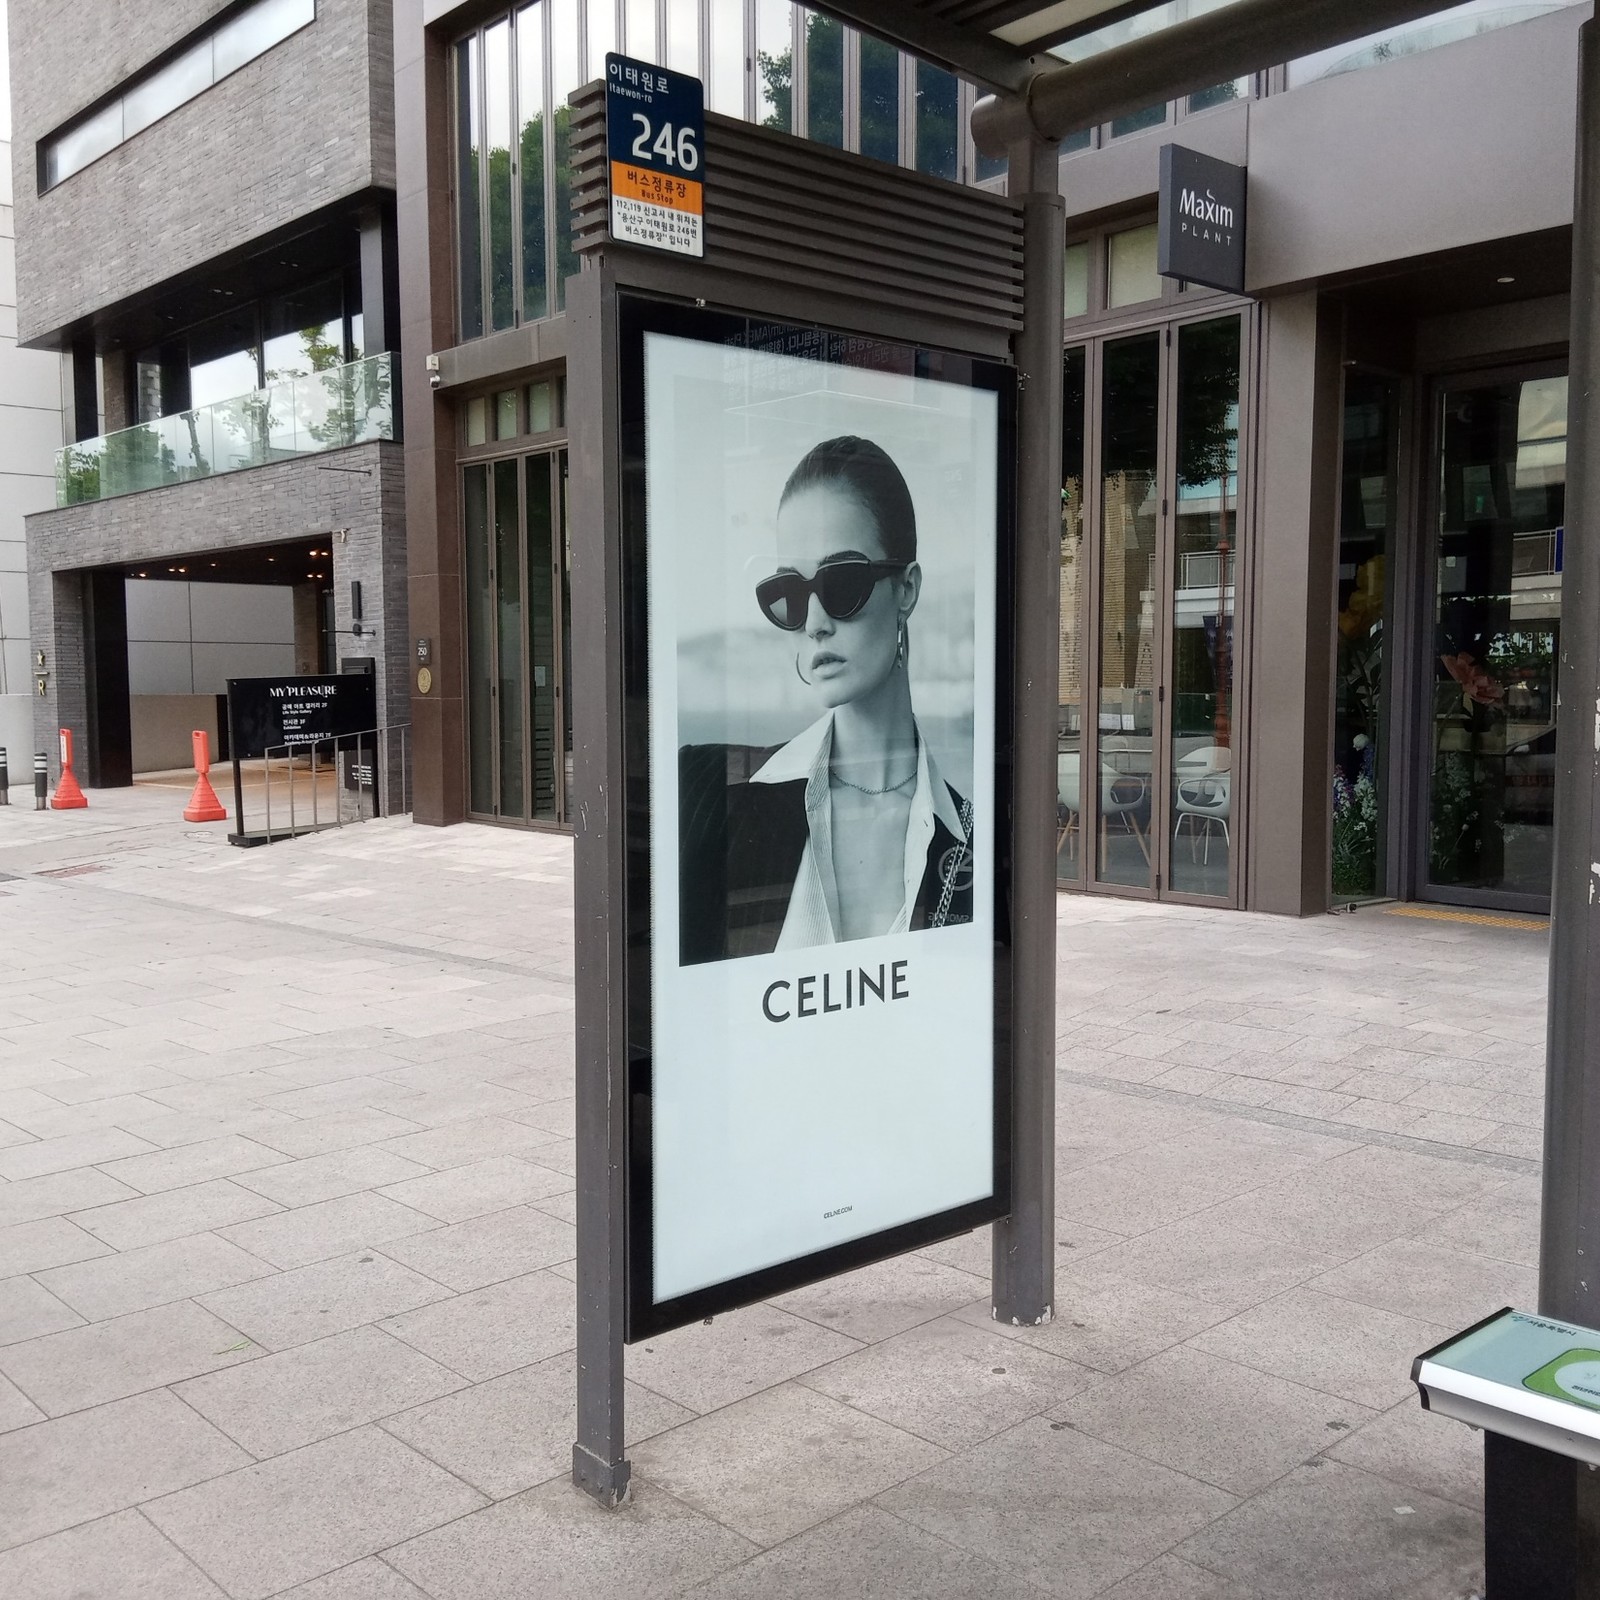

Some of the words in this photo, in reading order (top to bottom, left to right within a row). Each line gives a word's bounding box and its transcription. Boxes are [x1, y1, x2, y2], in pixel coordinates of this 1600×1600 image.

[609, 63, 669, 94] 이태원로
[609, 82, 653, 103] Itaewon-ro
[632, 113, 698, 172] 246
[627, 170, 686, 198] 버스정류장
[641, 189, 655, 200] Bus
[656, 193, 673, 205] Stop
[644, 206, 665, 219] 신고시
[668, 212, 674, 221] 내
[676, 214, 698, 227] 위치는
[1179, 188, 1233, 228] Maxim
[646, 218, 675, 233] 이태원로
[677, 225, 697, 239] 246번
[1181, 222, 1232, 246] PLANT
[762, 960, 909, 1023] CELINE
